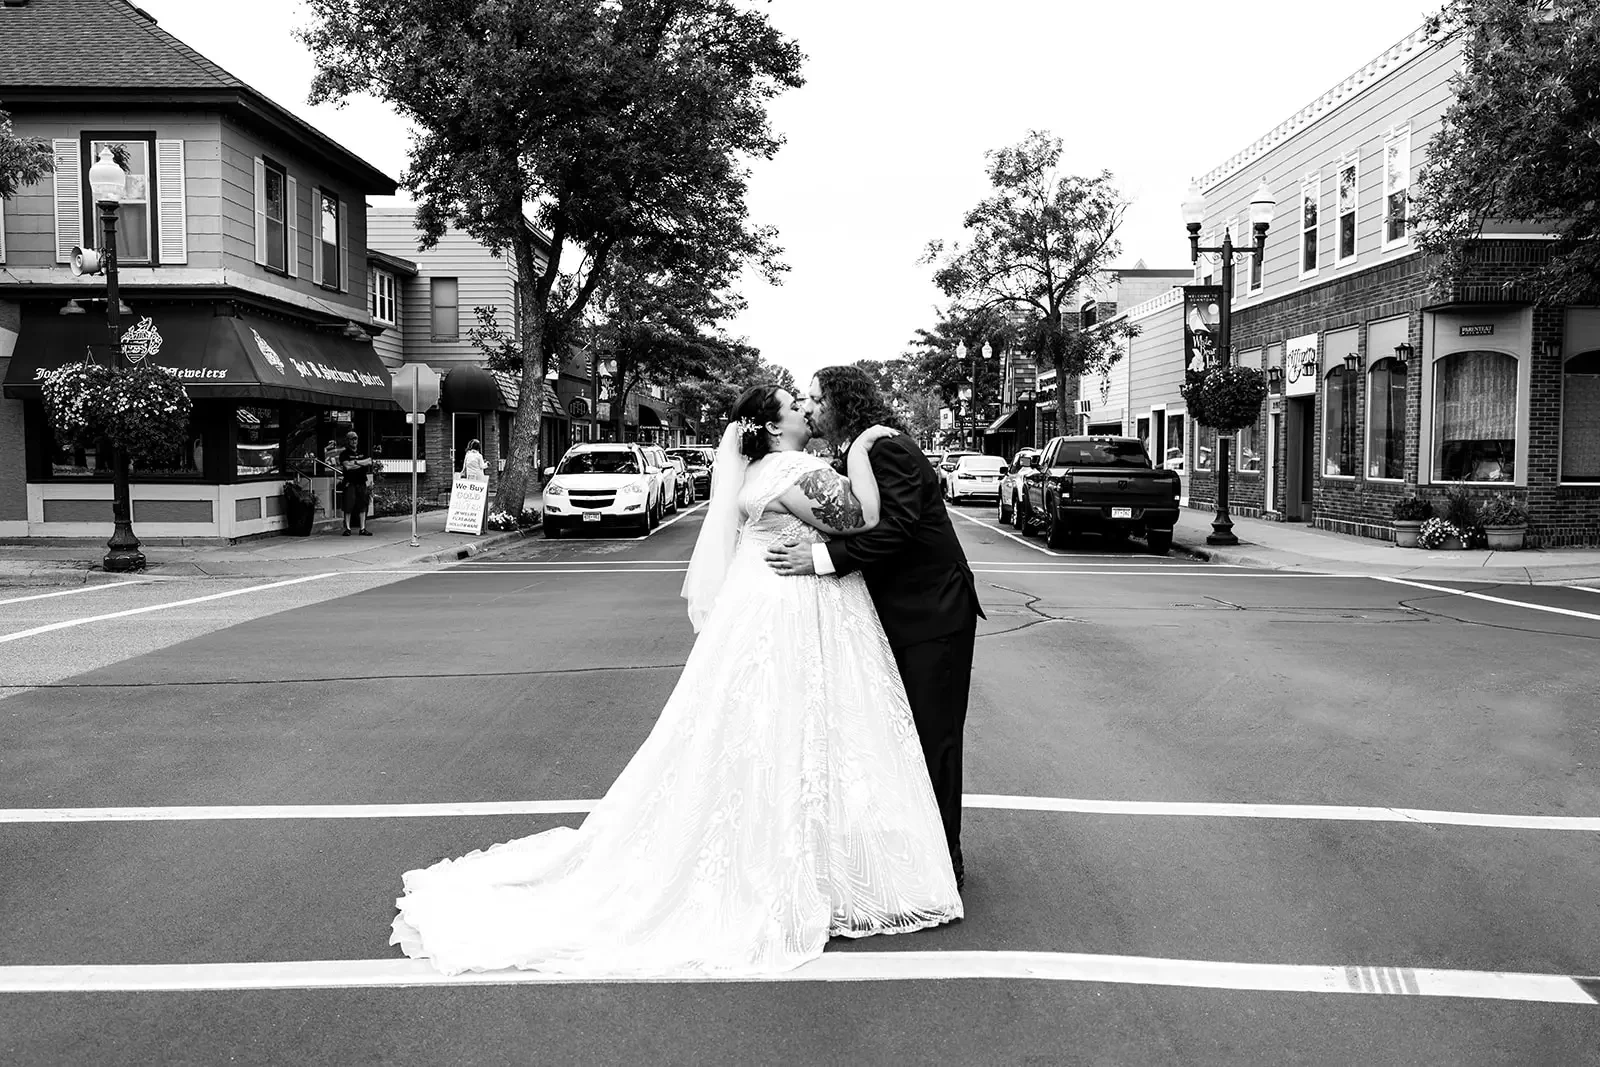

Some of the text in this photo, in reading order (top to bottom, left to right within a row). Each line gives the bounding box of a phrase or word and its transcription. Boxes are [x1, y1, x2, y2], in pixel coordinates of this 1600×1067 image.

[167, 367, 228, 379] Jewelers
[470, 484, 484, 492] Buy
[457, 491, 480, 500] GOLD
